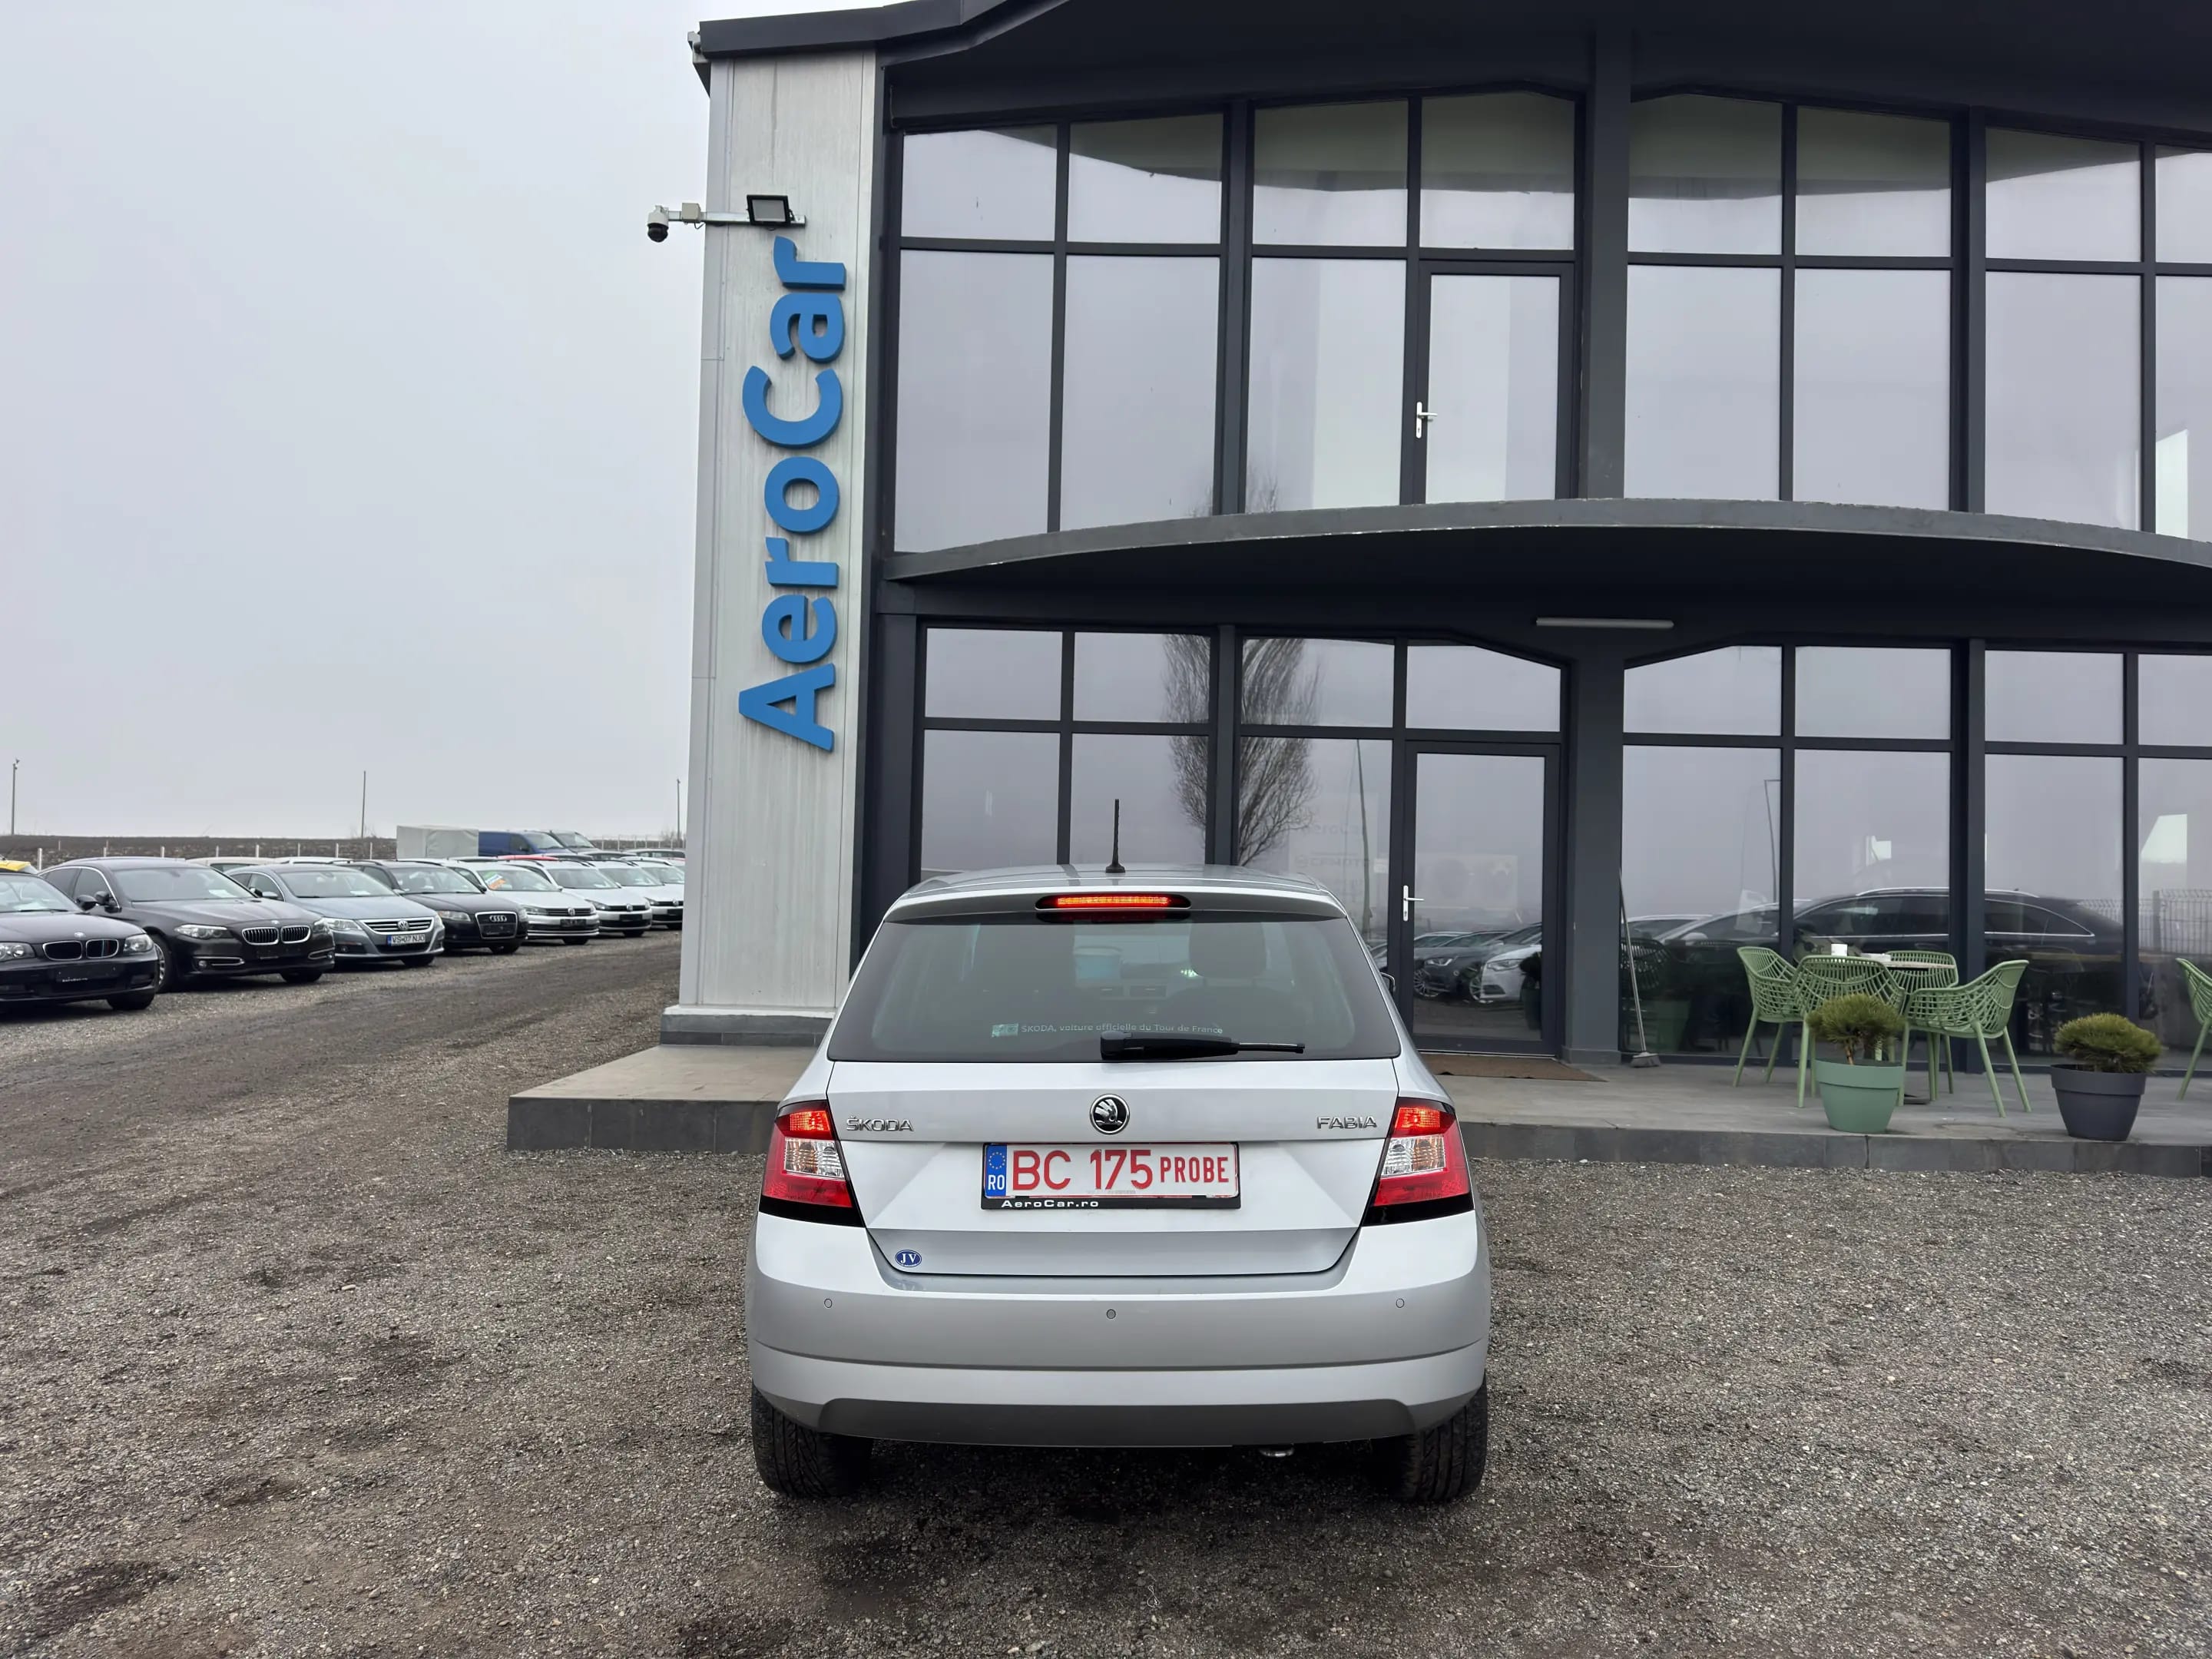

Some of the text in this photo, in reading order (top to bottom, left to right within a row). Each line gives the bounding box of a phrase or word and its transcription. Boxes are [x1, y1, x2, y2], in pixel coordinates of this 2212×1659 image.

[739, 235, 846, 752] AeroCar
[1060, 1023, 1094, 1031] voiture
[1096, 1022, 1137, 1031] officielle
[1140, 1023, 1152, 1031] du
[1154, 1024, 1174, 1032] Tour
[1192, 1025, 1224, 1035] France
[846, 1115, 914, 1131] ŠKODA
[1316, 1116, 1377, 1129] FABIA
[1012, 1149, 1229, 1190] BC 175 PROBE
[988, 1174, 1005, 1190] RO
[1001, 1199, 1099, 1208] AeroCar.ro
